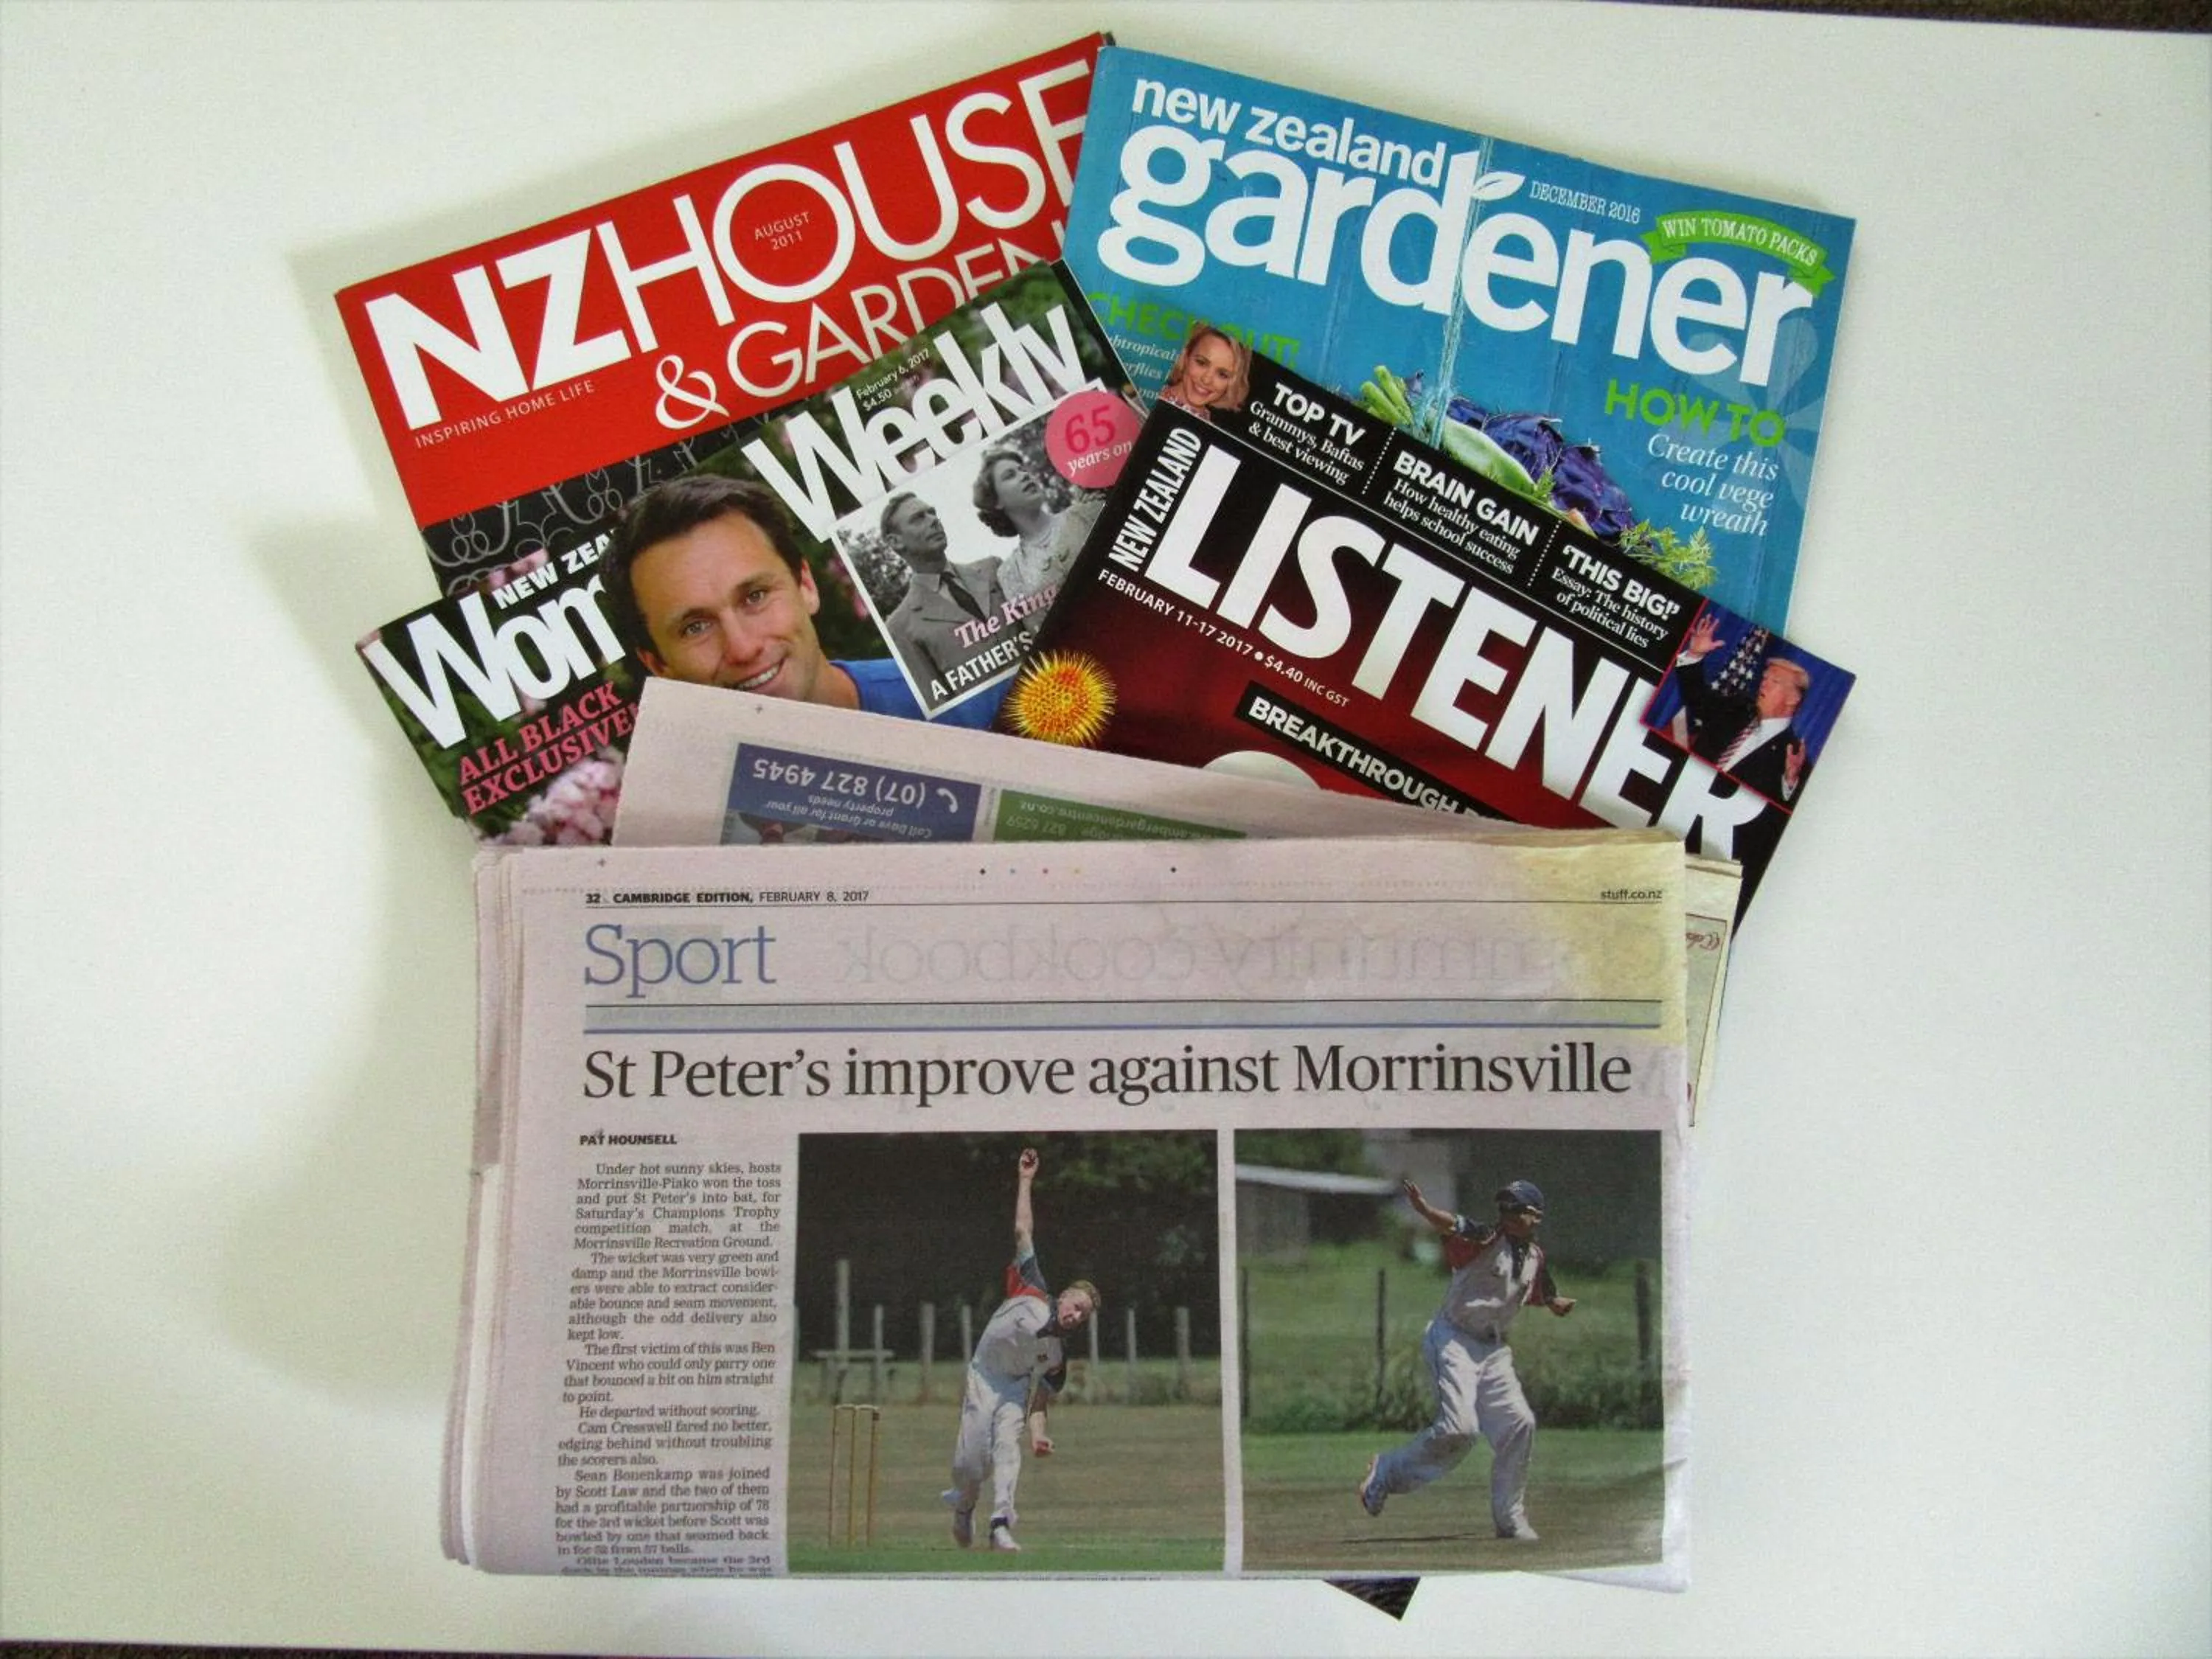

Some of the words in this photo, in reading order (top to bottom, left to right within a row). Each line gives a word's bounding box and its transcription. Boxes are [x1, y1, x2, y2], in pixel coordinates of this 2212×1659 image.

[1133, 78, 1241, 135] new
[1248, 105, 1446, 189] zealand
[1529, 181, 1607, 216] DECEMBER
[1609, 201, 1641, 223] 2016
[754, 212, 811, 240] AUGUST
[771, 230, 804, 251] 2011
[1662, 217, 1696, 239] WIN
[1701, 218, 1766, 246] TOMATO
[1769, 234, 1818, 266] PACKS
[1098, 124, 1813, 386] gardener
[655, 355, 728, 431] &
[856, 371, 897, 400] February
[908, 348, 929, 368] 2017
[414, 411, 501, 448] INSPIRING
[506, 394, 555, 420] HOME
[559, 380, 595, 402] LIFE
[863, 389, 891, 411] $4.50
[1273, 383, 1325, 423] TOP
[1329, 413, 1366, 445] TV
[1604, 378, 1720, 436] HOW
[1727, 403, 1785, 447] TO
[1065, 406, 1116, 453] 65
[1250, 401, 1317, 447] Grammys,
[1321, 437, 1364, 472] Baftas
[1068, 448, 1110, 476] years
[1113, 440, 1133, 456] on
[1248, 421, 1262, 437] &
[1262, 427, 1293, 453] best
[1295, 444, 1350, 486] viewing
[1648, 434, 1729, 470] Create
[1732, 451, 1779, 481] this
[1108, 513, 1158, 571] NEW
[1133, 427, 1201, 522] ZEALAND
[1393, 451, 1475, 510] BRAIN
[1476, 498, 1540, 546] GAIN
[1661, 469, 1717, 497] cool
[1719, 482, 1774, 513] vege
[1383, 493, 1421, 526] helps
[1420, 515, 1467, 548] school
[1465, 540, 1514, 575] success
[1394, 478, 1429, 505] How
[1427, 495, 1478, 535] healthy
[1478, 525, 1522, 561] eating
[1680, 504, 1769, 536] wreath
[492, 562, 559, 609] NEW
[561, 528, 616, 574] ZEA
[1551, 566, 1593, 599] Essay:
[1595, 587, 1622, 614] The
[1621, 602, 1669, 641] history
[1556, 591, 1574, 609] of
[1569, 598, 1627, 636] political
[1624, 625, 1650, 650] lies
[954, 616, 1001, 648] The
[1098, 568, 1174, 616] FEBRUARY
[1177, 611, 1216, 636] 11-17
[1217, 630, 1253, 656] 2017
[1264, 655, 1303, 683] $4.40
[1304, 678, 1326, 696] INC
[1326, 690, 1350, 707] GST
[1144, 444, 1769, 860] LISTENER
[931, 679, 947, 700] A
[945, 631, 1033, 693] FATHER'S
[459, 737, 519, 785] ALL
[519, 681, 623, 754] BLACK
[1248, 695, 1459, 814] BREAKTHROUGH
[753, 759, 815, 786] 4945
[821, 770, 868, 796] 827
[875, 776, 926, 809] (07)
[844, 800, 894, 817] property
[586, 894, 600, 903] 32
[613, 892, 691, 904] CAMBRIDGE
[696, 891, 754, 904] EDITION,
[759, 891, 821, 902] FEBRUARY
[827, 891, 838, 903] 8,
[843, 890, 869, 901] 2017
[1601, 888, 1663, 901] stuff.co.nz
[585, 924, 776, 998] Sport
[583, 1050, 636, 1098] St
[844, 1048, 1075, 1107] improve
[1088, 1044, 1279, 1106] against
[1293, 1042, 1632, 1093] Morrinsville
[580, 1135, 605, 1145] PAT
[608, 1135, 677, 1144] HOUNSELL
[596, 1164, 635, 1175] Under
[639, 1164, 660, 1175] hot
[664, 1165, 701, 1176] sunny
[709, 1163, 743, 1175] skies,
[749, 1162, 781, 1174] hosts
[703, 1180, 728, 1189] won
[733, 1177, 752, 1188] the
[757, 1179, 781, 1188] toss
[577, 1194, 599, 1205] and
[606, 1195, 627, 1206] put
[634, 1193, 646, 1204] St
[702, 1192, 727, 1203] into
[734, 1192, 756, 1203] bat,
[762, 1192, 781, 1203] for
[653, 1207, 724, 1220] Champions
[733, 1206, 780, 1220] Trophy
[574, 1222, 651, 1236] competition
[729, 1222, 741, 1232] at
[759, 1221, 779, 1232] the
[574, 1237, 650, 1250] Morrinsville
[655, 1237, 718, 1248] Recreation
[723, 1236, 773, 1248] Ground.
[591, 1253, 613, 1264] The
[618, 1253, 658, 1263] wicket
[663, 1254, 684, 1263] was
[688, 1253, 712, 1265] very
[718, 1253, 752, 1265] green
[756, 1251, 779, 1262] and
[568, 1313, 626, 1326] although
[634, 1312, 654, 1324] the
[661, 1312, 683, 1324] odd
[691, 1312, 742, 1325] delivery
[751, 1312, 776, 1322] also
[580, 1407, 597, 1418] He
[599, 1405, 655, 1420] departed
[658, 1405, 706, 1416] without
[711, 1405, 759, 1418] scoring.
[558, 1455, 577, 1467] the
[580, 1455, 627, 1466] scorers
[630, 1453, 658, 1465] also.
